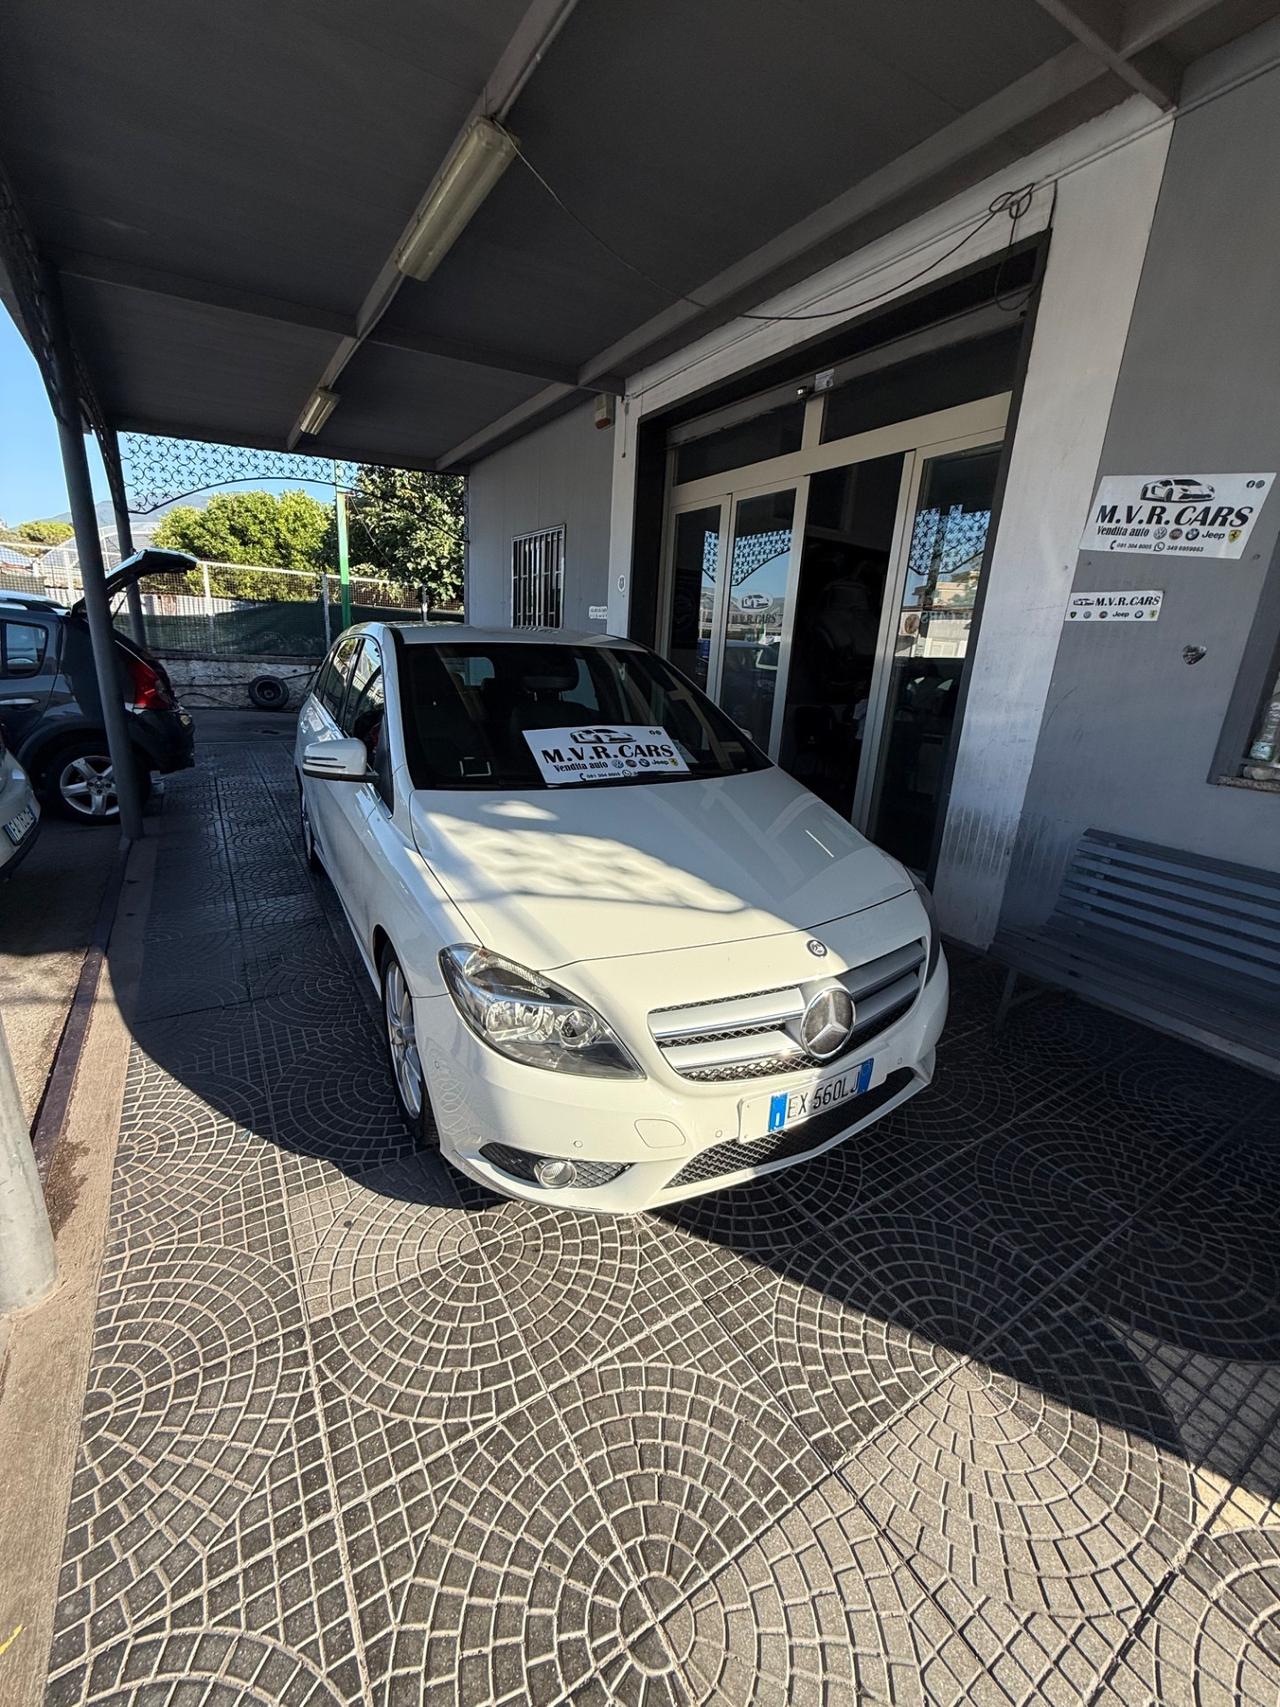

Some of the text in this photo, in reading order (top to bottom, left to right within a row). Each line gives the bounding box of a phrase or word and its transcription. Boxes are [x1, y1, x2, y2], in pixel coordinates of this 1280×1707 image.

[1097, 525, 1127, 537] Vendita
[1128, 527, 1150, 537] auto
[1201, 530, 1226, 541] Jeep
[553, 761, 588, 773] Vendita
[589, 760, 609, 770] auto
